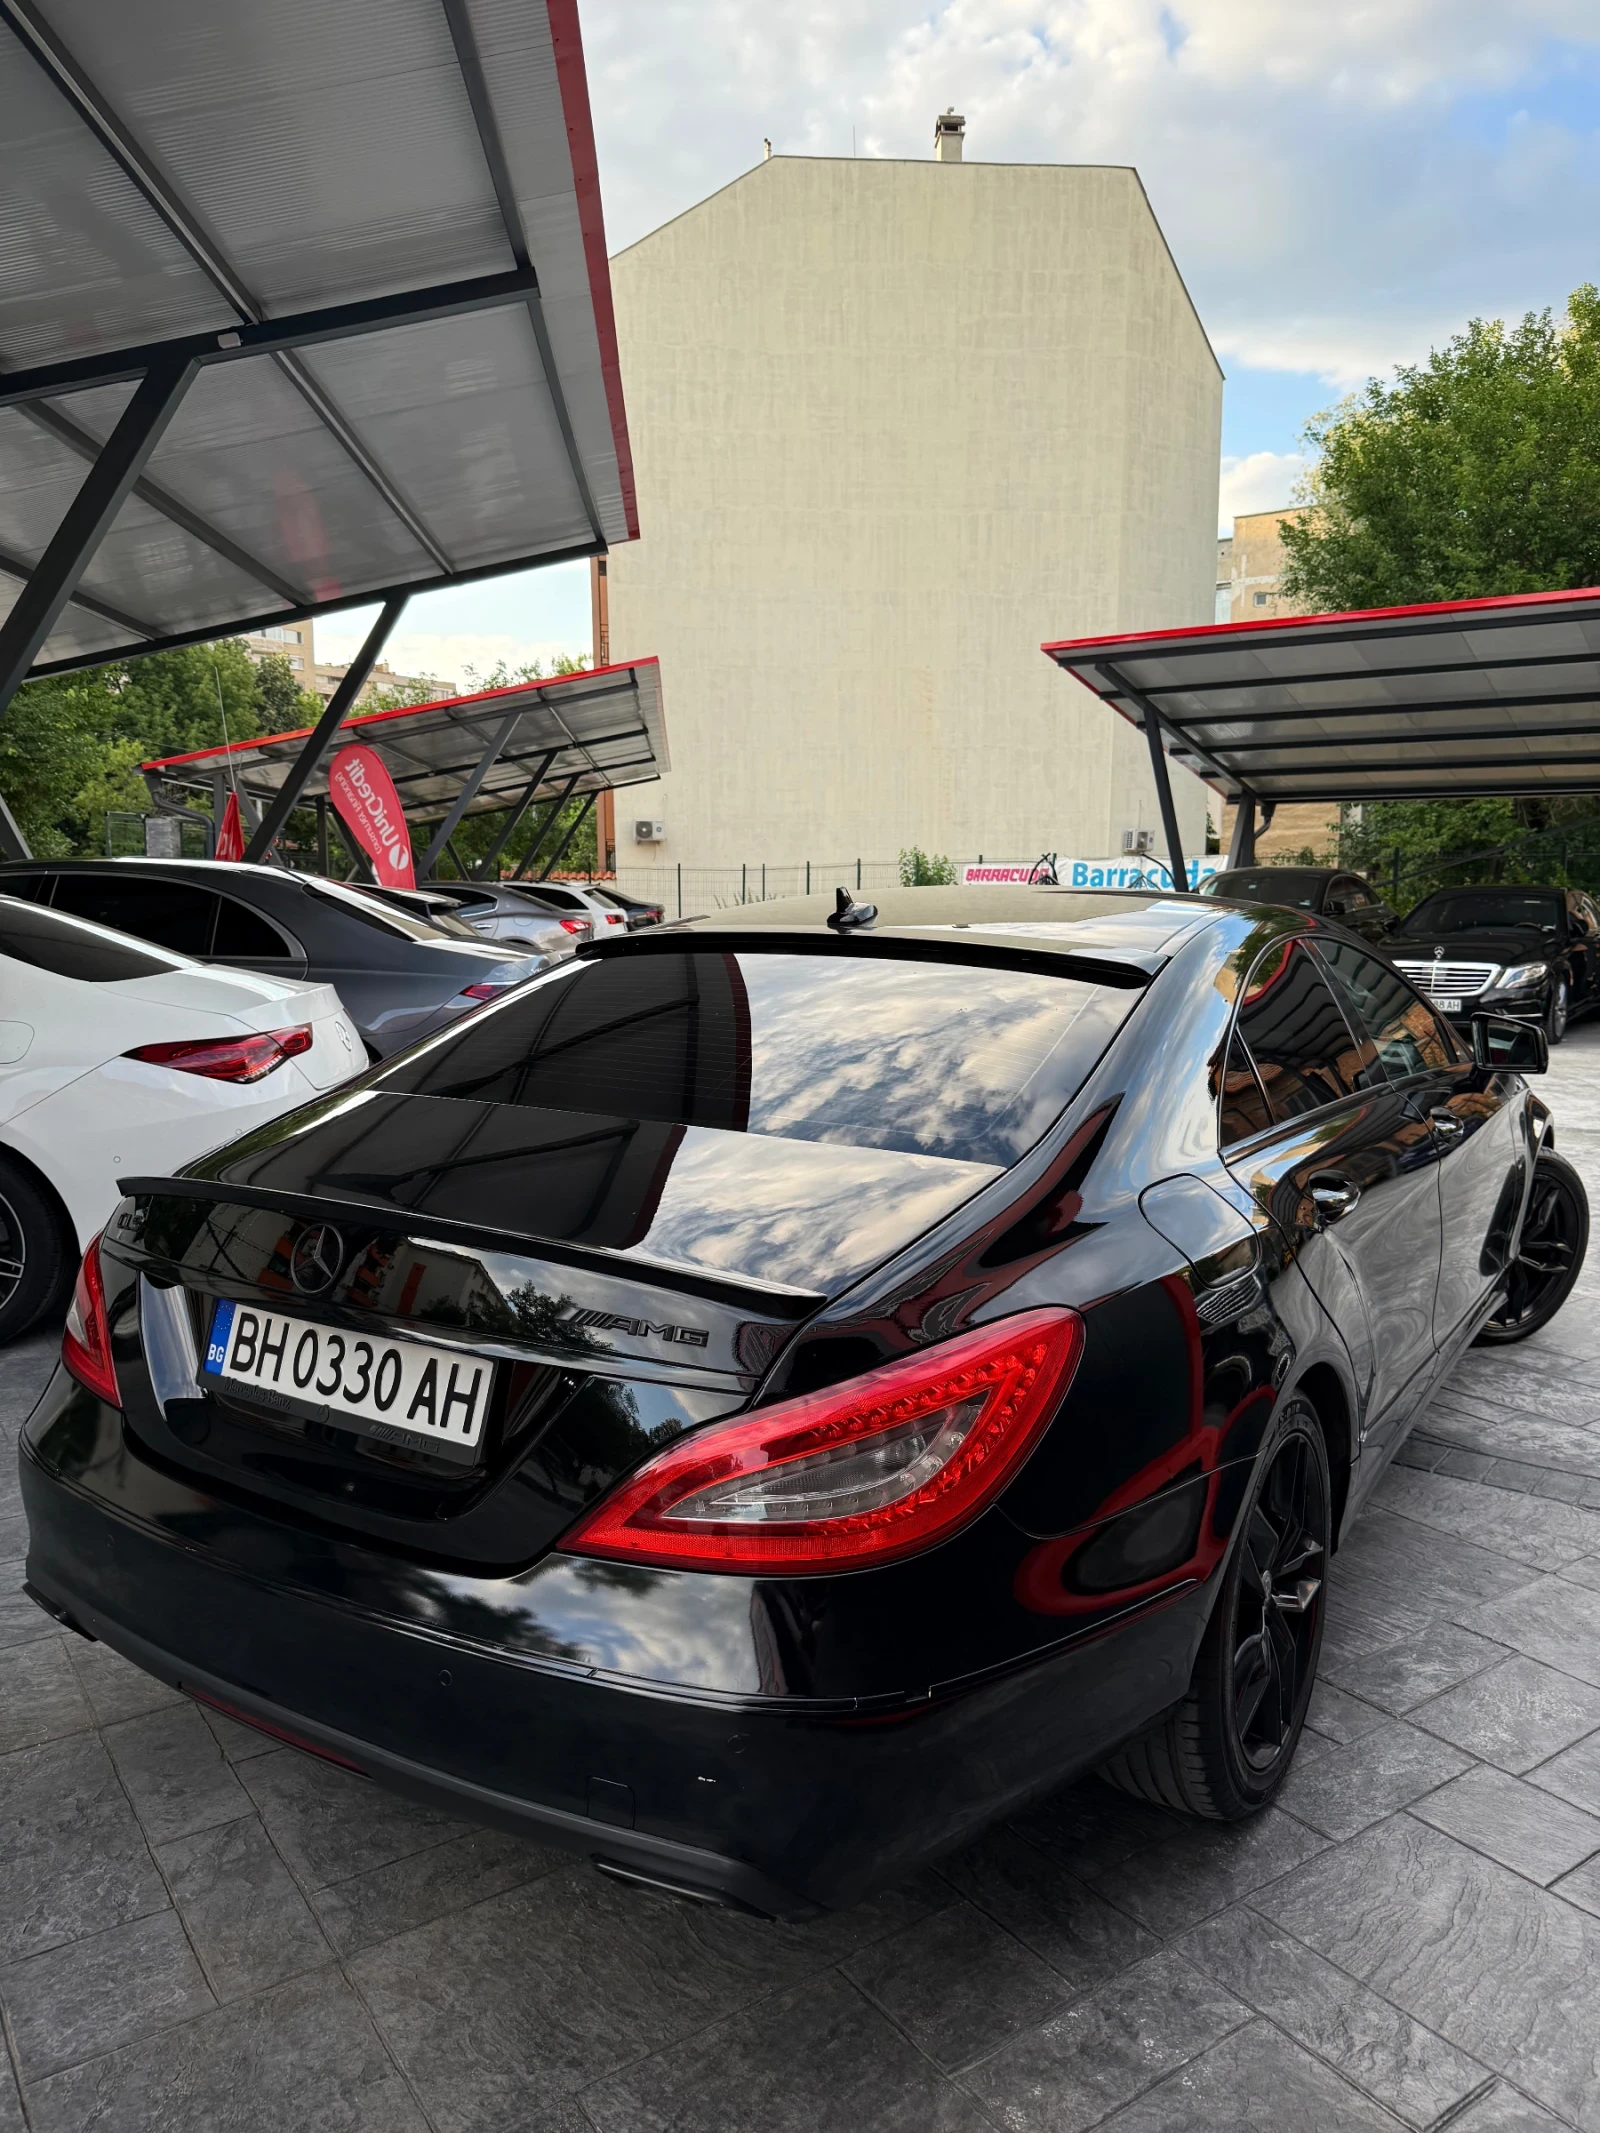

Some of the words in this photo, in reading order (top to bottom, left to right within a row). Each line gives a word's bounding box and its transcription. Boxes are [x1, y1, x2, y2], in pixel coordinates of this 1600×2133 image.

[1447, 1000, 1459, 1010] AH
[601, 1313, 710, 1348] AMG
[207, 1343, 223, 1363] BG
[229, 1311, 290, 1382] BH
[293, 1328, 402, 1412] 0330
[406, 1357, 482, 1435] AH
